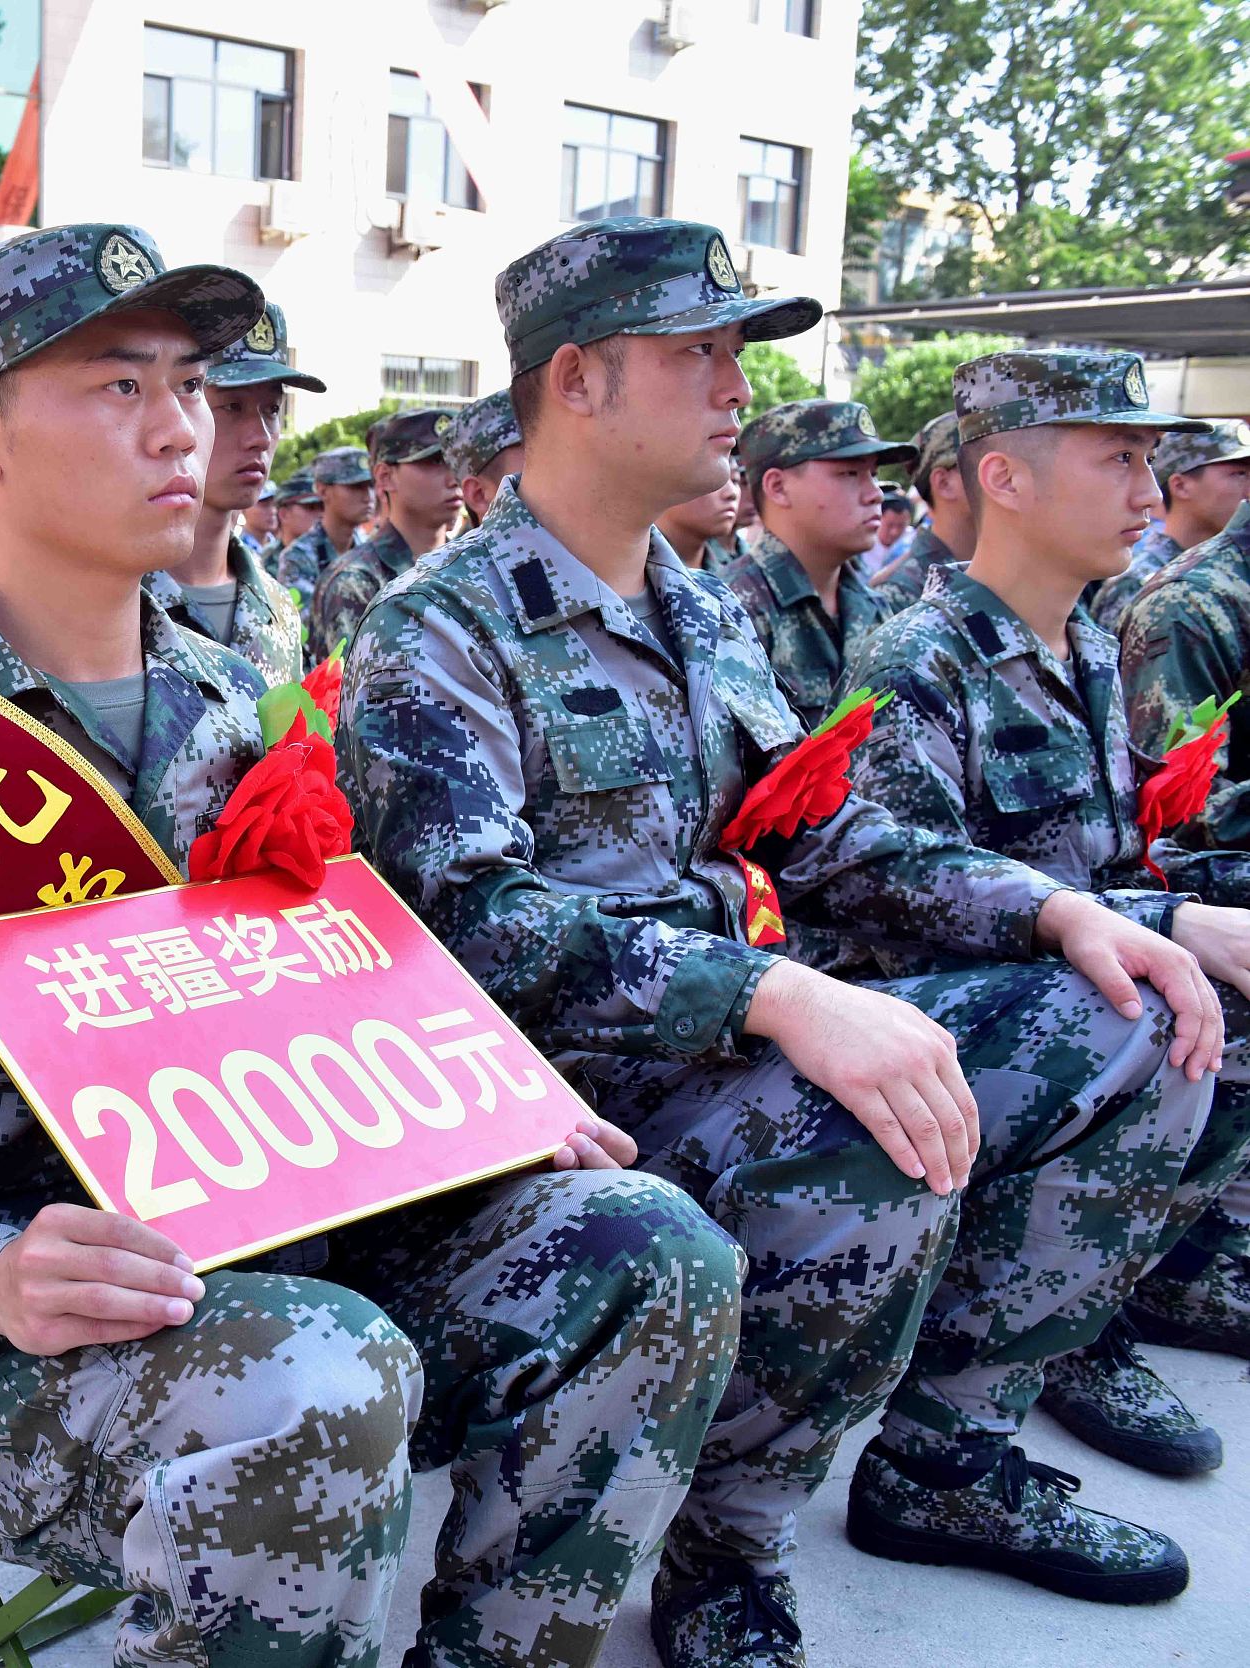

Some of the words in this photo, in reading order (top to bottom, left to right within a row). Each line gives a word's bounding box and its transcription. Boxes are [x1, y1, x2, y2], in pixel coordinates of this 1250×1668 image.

[24, 898, 393, 1035] 进疆奖励
[71, 1006, 547, 1222] 20000元
